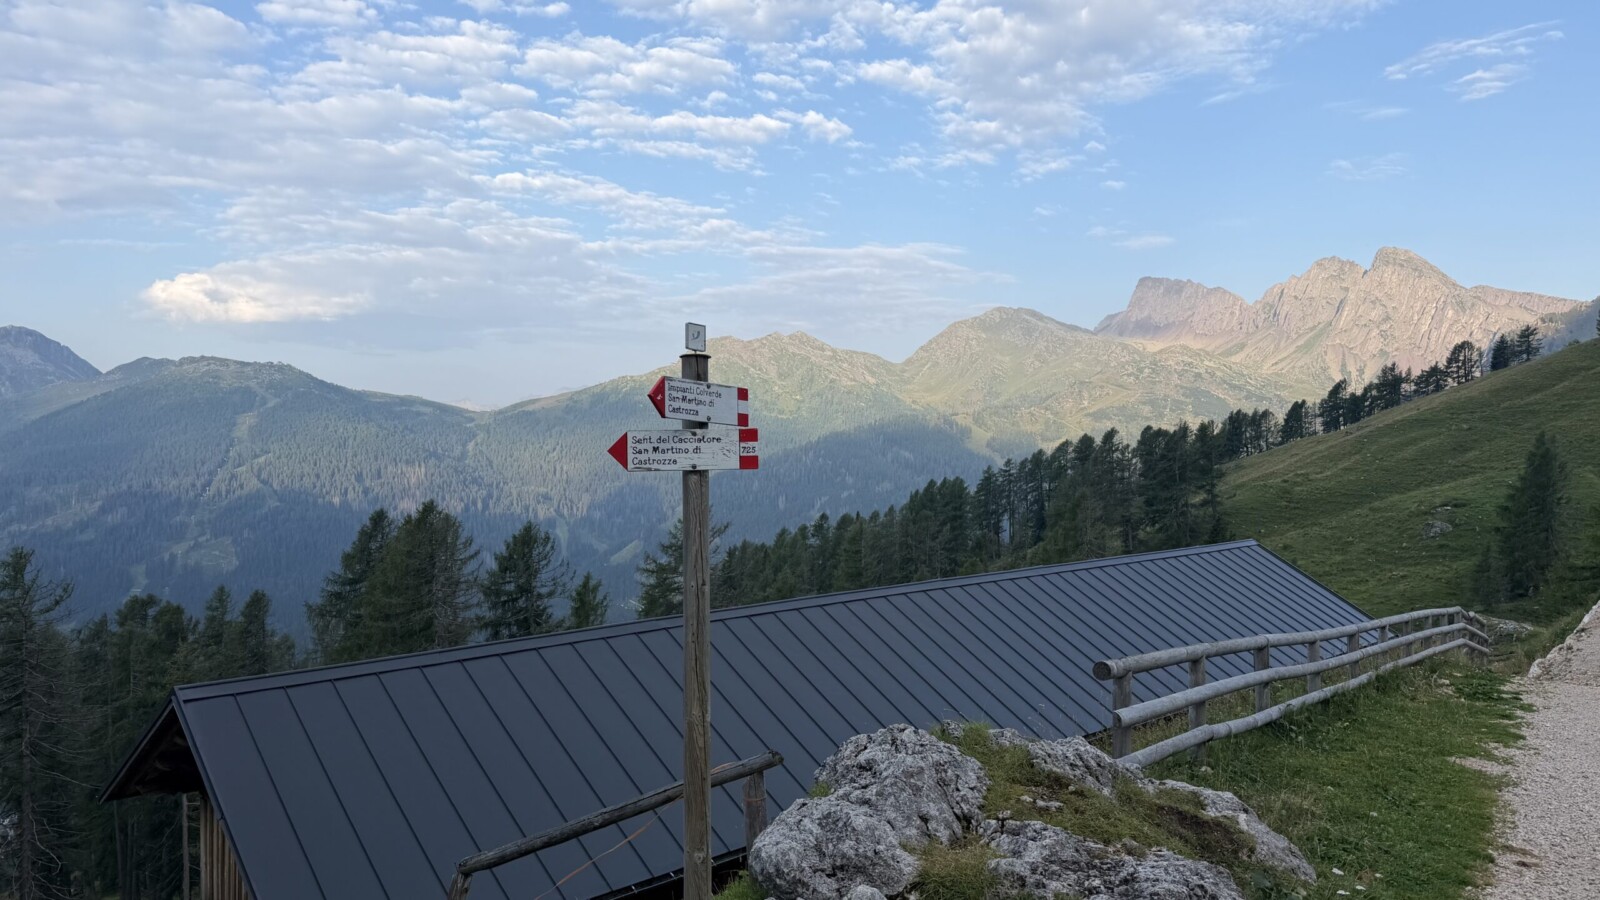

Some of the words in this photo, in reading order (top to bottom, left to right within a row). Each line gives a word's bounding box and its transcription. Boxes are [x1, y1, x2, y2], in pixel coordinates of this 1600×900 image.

[668, 383, 695, 394] Impianti
[696, 387, 722, 399] Colverde
[668, 393, 680, 402] San
[681, 396, 706, 406] Martino
[708, 399, 714, 408] di
[668, 404, 699, 416] Castrozza
[632, 435, 656, 444] Sent.
[656, 436, 670, 444] del
[672, 435, 722, 444] Cacciatore
[632, 446, 649, 454] San
[652, 445, 690, 454] Martino
[692, 446, 702, 454] di
[632, 456, 678, 466] Castrozza
